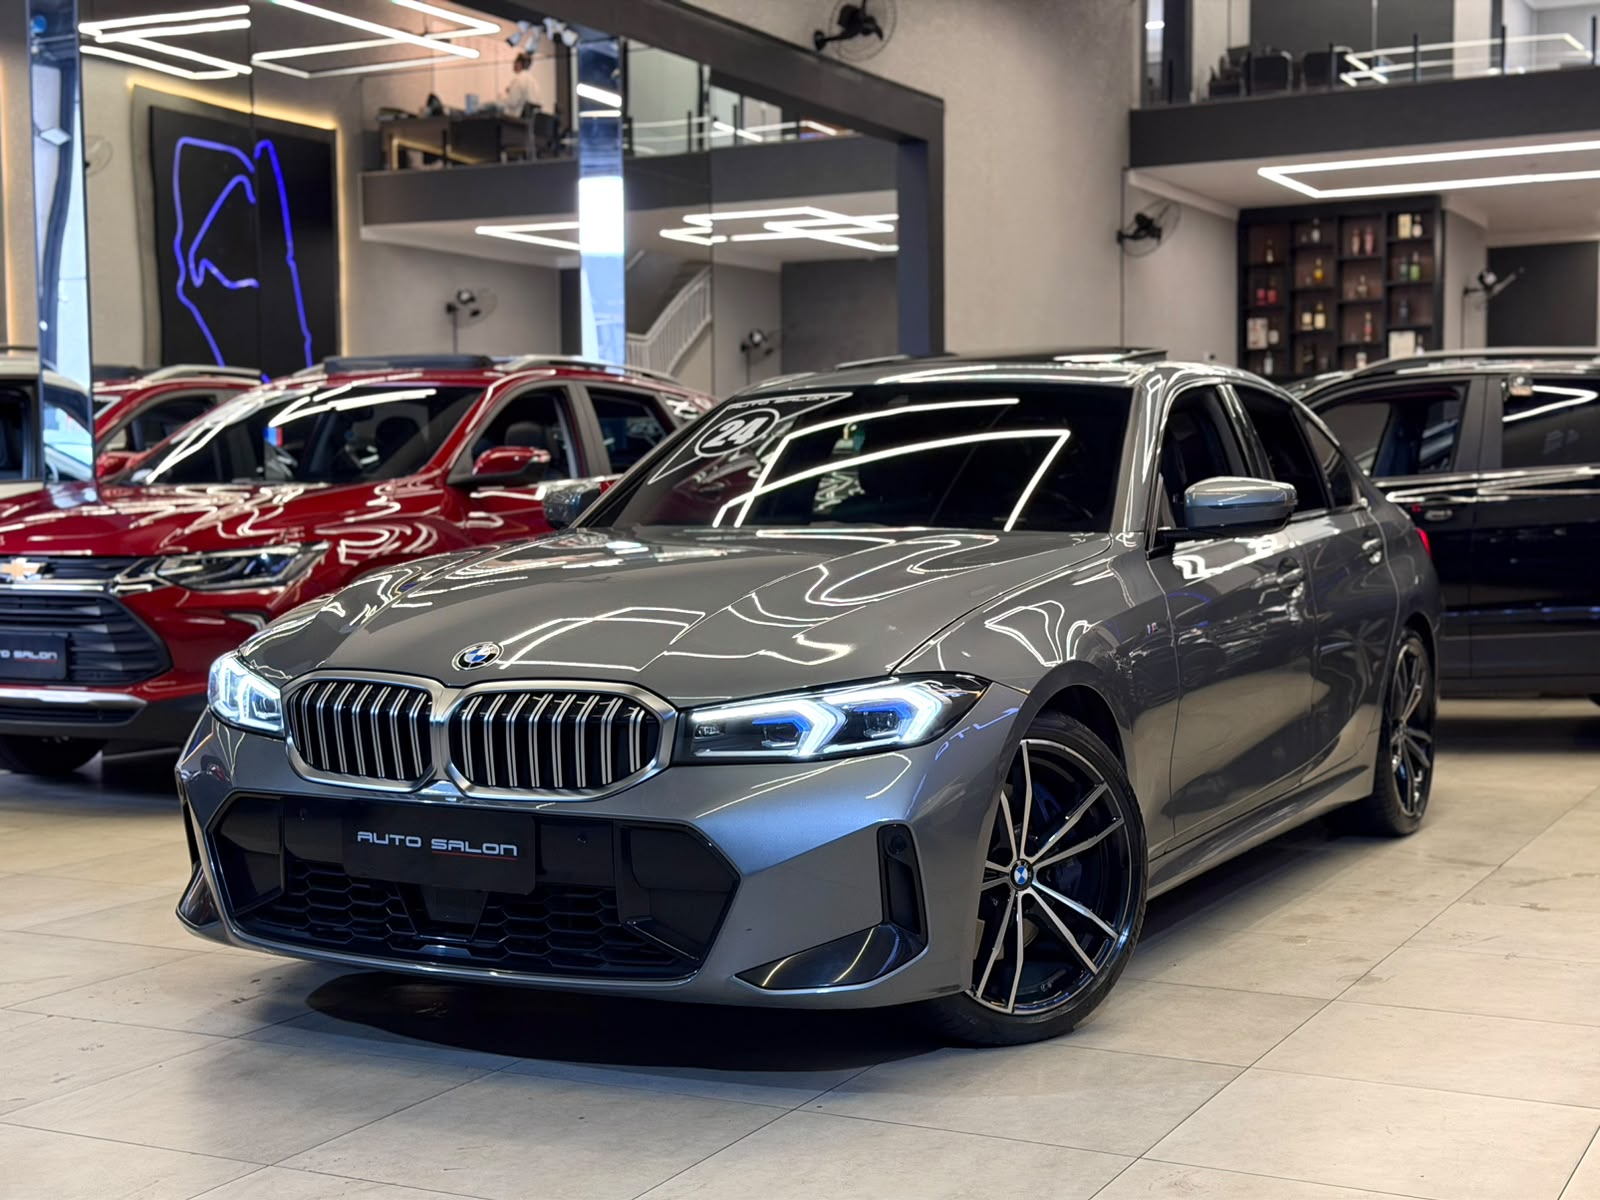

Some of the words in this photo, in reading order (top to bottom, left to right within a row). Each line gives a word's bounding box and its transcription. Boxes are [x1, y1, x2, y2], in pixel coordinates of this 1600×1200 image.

[701, 416, 769, 449] 24
[357, 831, 422, 848] AUTO
[431, 838, 518, 857] SALON
